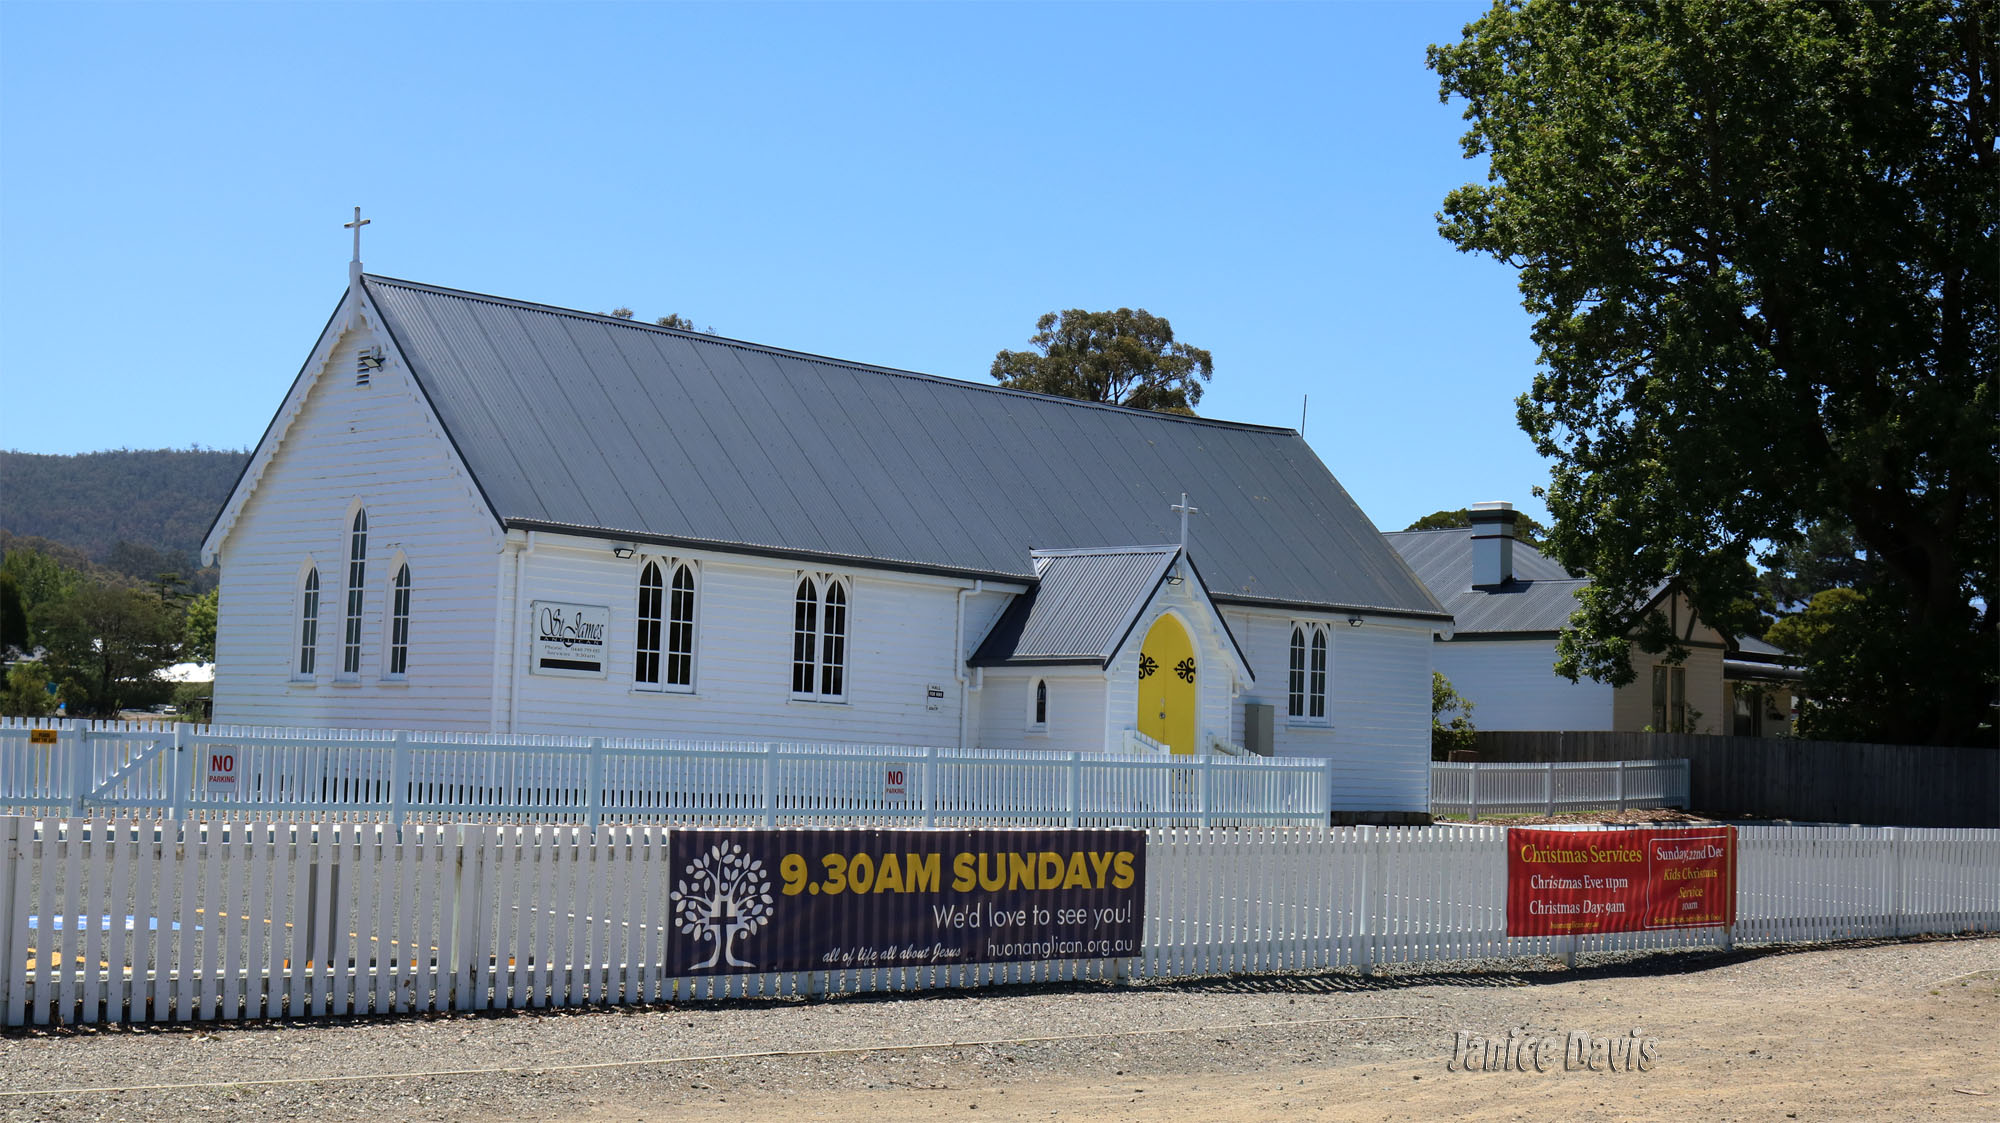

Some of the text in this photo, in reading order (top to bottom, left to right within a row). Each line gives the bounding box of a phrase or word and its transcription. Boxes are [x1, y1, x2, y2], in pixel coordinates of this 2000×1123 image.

[562, 611, 604, 648] James
[543, 637, 600, 645] ANGLICAN
[212, 754, 234, 772] NO
[209, 775, 235, 783] PARKING
[888, 770, 904, 785] NO
[1521, 843, 1643, 864] Christmas Services
[1707, 844, 1724, 859] Dec
[779, 851, 1135, 896] 9.30AM SUNDAYS
[1663, 866, 1718, 881] Kids Christmas
[1530, 874, 1629, 893] Christmas Eve: 11pm
[1679, 885, 1704, 898] Service
[933, 900, 1132, 931] We'd love to see you!
[1529, 899, 1626, 918] Christmas Day: 9am
[822, 941, 962, 967] all of life all about Jesus
[987, 936, 1134, 958] huonanglican.org.au
